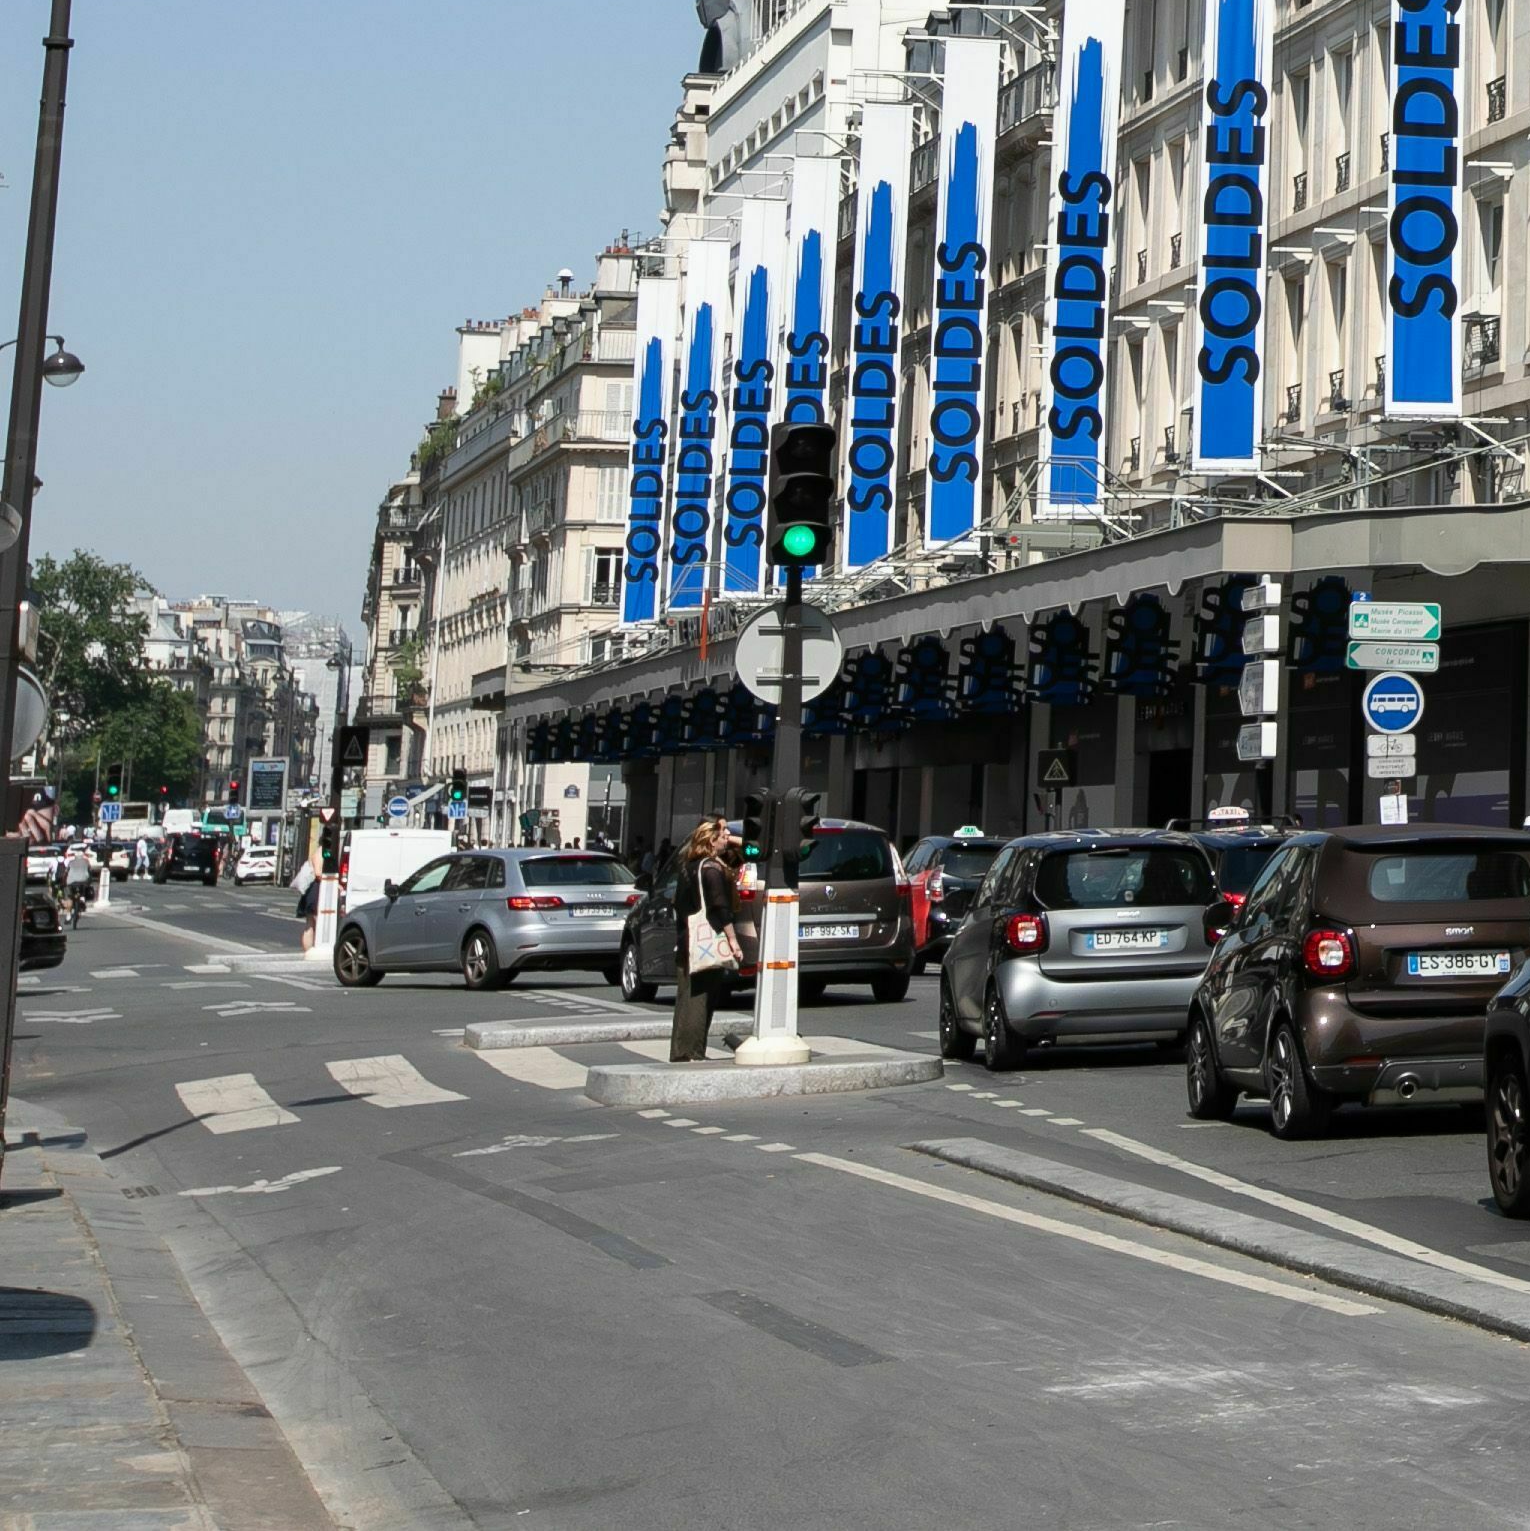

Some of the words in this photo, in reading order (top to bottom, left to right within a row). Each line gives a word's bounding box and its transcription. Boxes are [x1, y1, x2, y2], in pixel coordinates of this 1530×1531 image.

[1048, 170, 1112, 441] SOLDES
[1198, 78, 1268, 386] SOLDES
[784, 330, 830, 423] DES
[846, 290, 901, 513] SOLDES
[929, 242, 987, 484] SOLDES
[624, 418, 668, 583] SOLDES
[670, 389, 718, 566] SOLDES
[724, 358, 774, 548] SOLDES
[1360, 592, 1367, 601] 2
[1370, 607, 1393, 615] Musée
[1398, 608, 1424, 616] Picasso
[1375, 647, 1420, 656] CONCORDE
[1386, 657, 1394, 665] Le
[1445, 926, 1474, 936] smart
